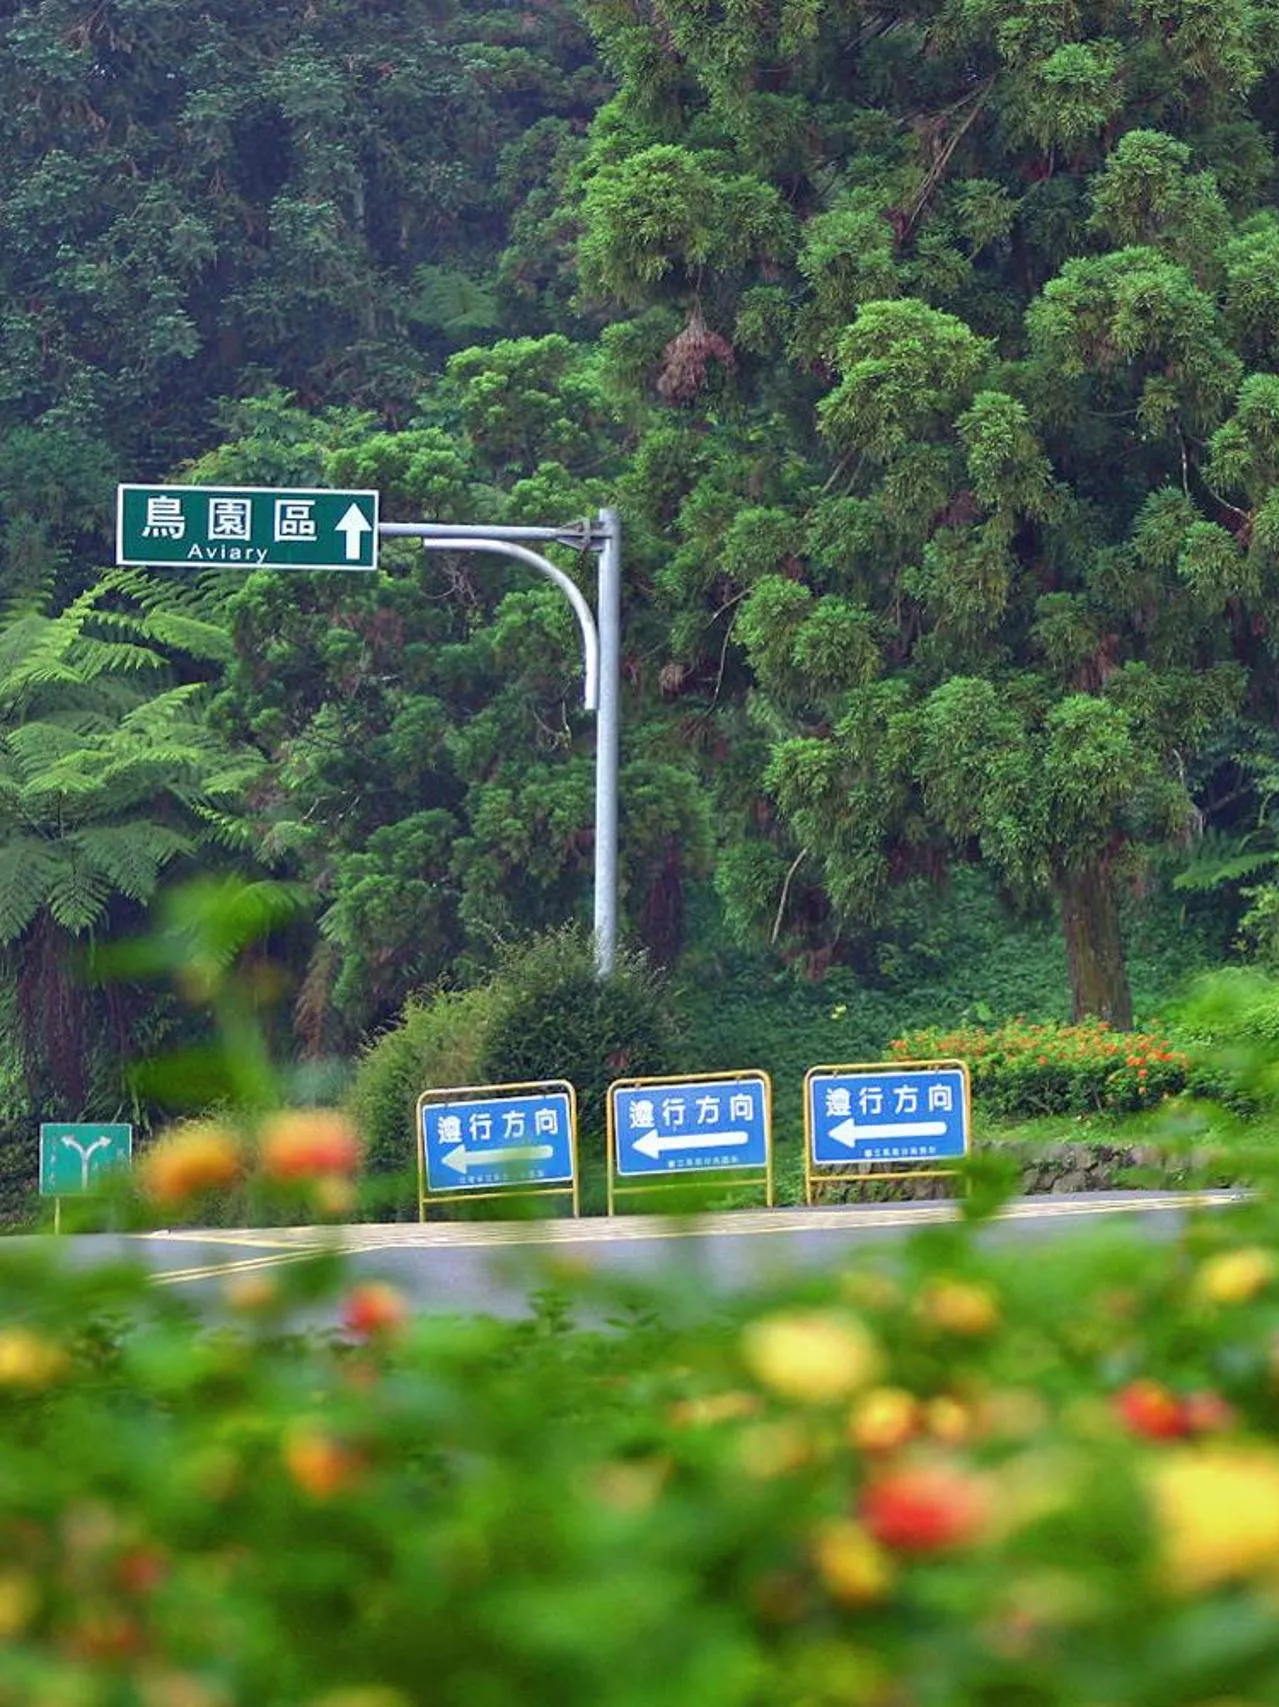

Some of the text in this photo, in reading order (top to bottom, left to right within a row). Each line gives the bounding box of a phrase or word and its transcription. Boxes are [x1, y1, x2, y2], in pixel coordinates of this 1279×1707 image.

[142, 495, 317, 541] 鳥園區
[187, 543, 268, 564] Aviary
